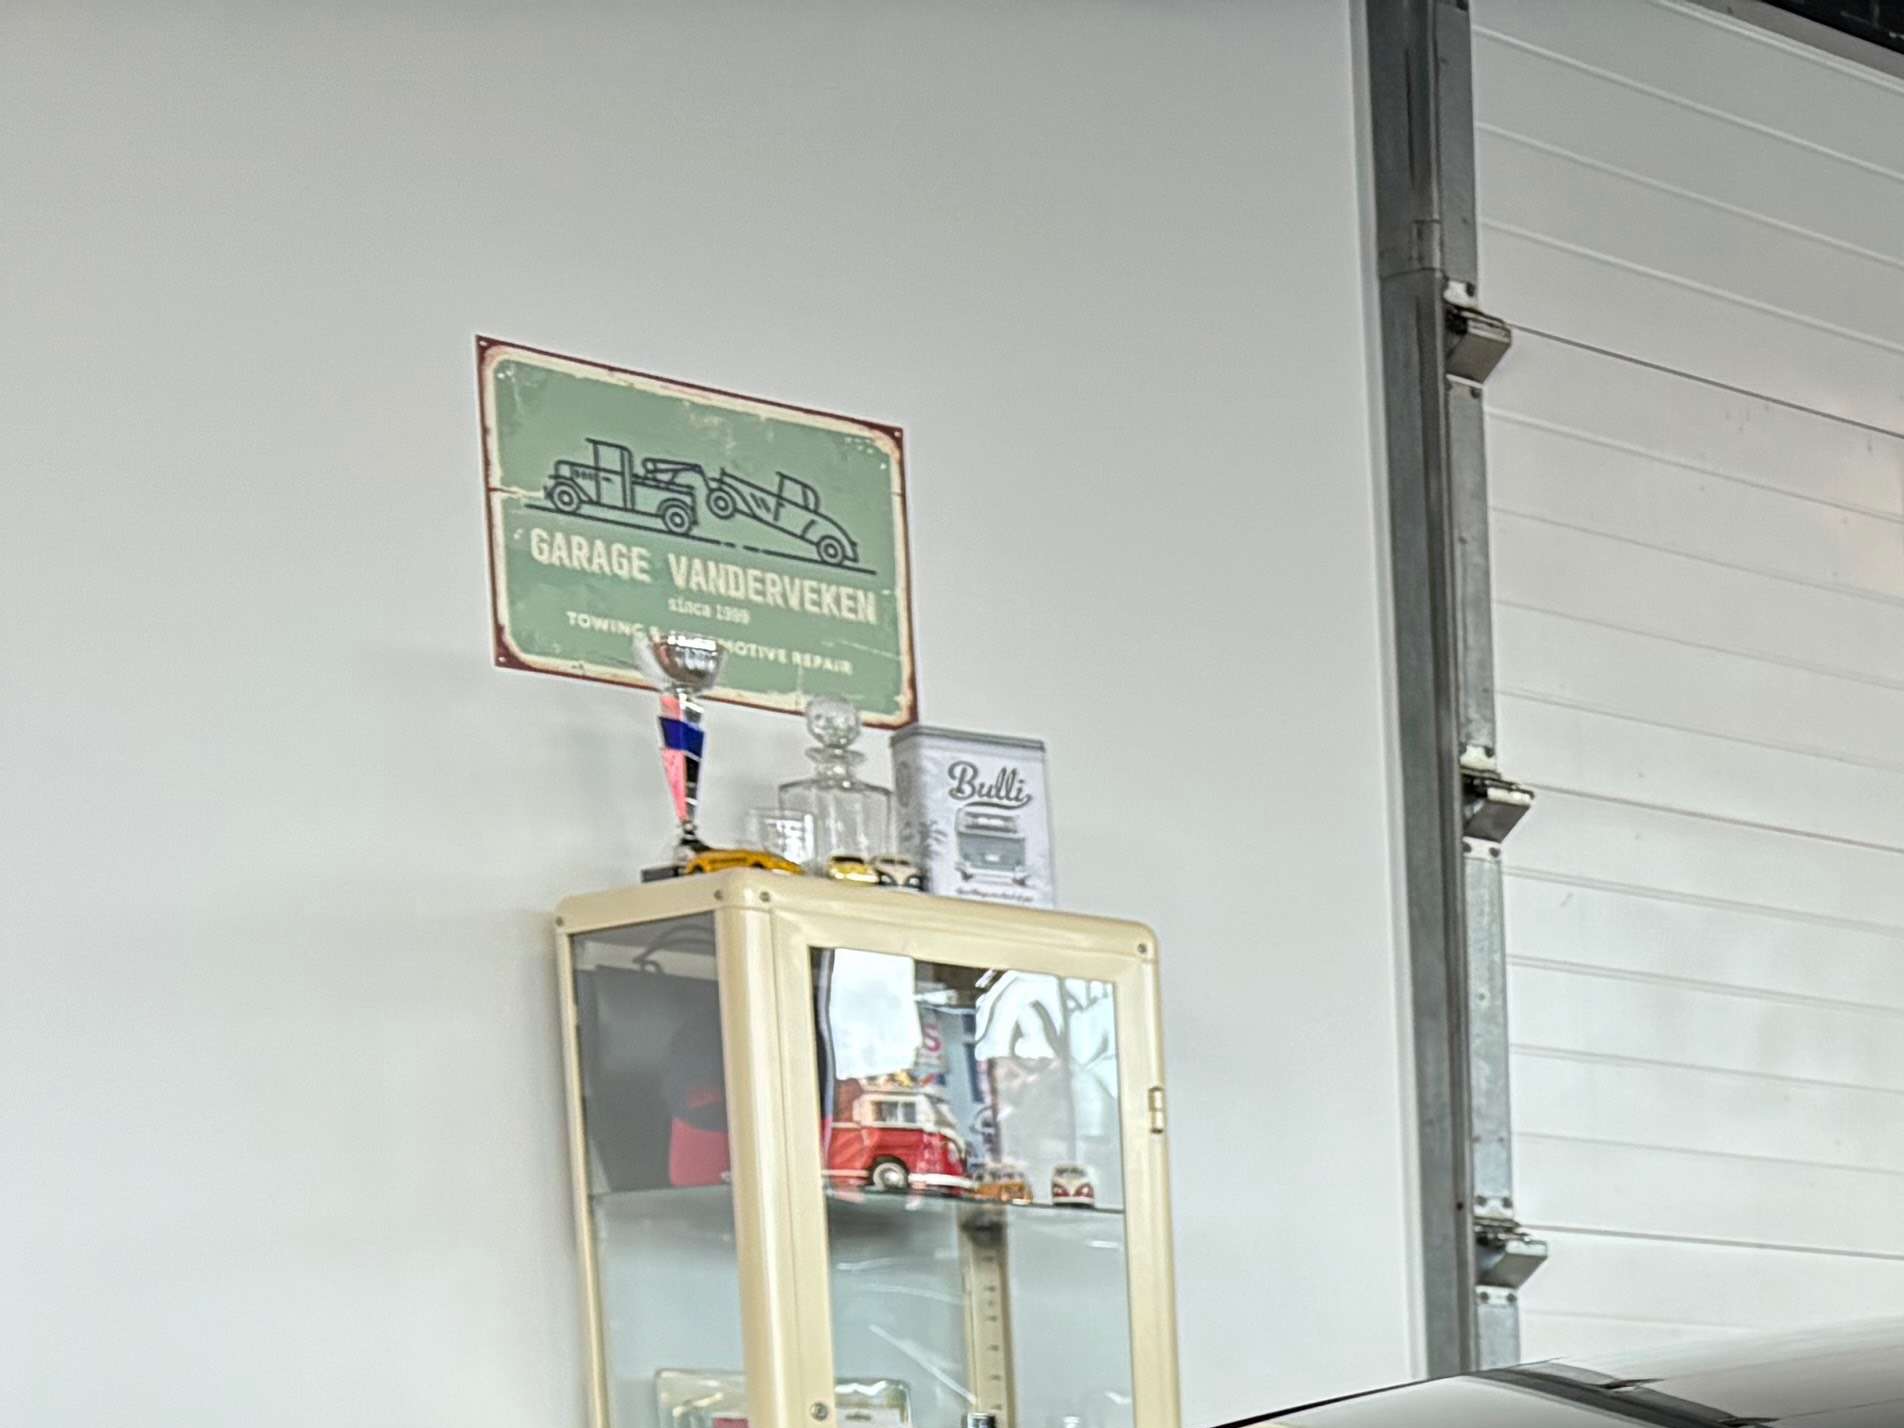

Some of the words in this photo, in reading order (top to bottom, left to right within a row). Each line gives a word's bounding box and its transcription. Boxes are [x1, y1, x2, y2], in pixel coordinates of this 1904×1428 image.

[530, 527, 650, 580] GARAGE
[667, 553, 876, 624] VANDERVEKEN
[566, 611, 645, 638] TOWING
[791, 651, 854, 675] REPAIR
[948, 760, 1033, 810] Bulli
